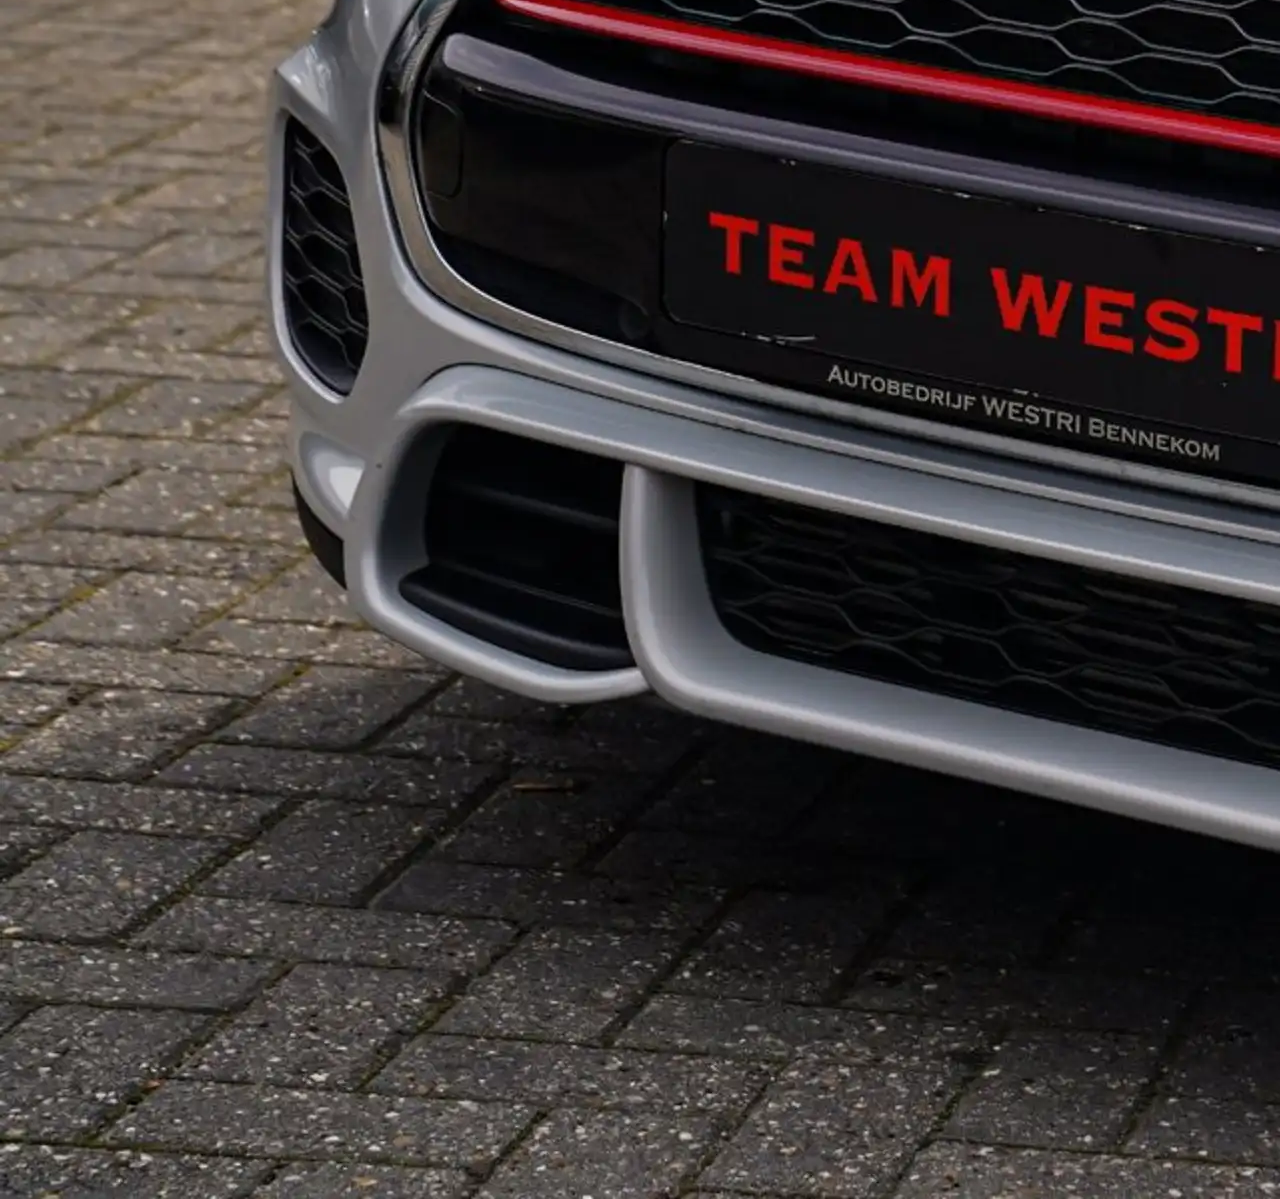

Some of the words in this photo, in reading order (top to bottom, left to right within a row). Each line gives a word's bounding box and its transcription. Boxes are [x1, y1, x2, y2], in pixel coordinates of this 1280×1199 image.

[708, 212, 951, 316] TEAM
[827, 364, 977, 412] AUTOBEDRIJF
[982, 395, 1082, 434] WESTRI
[1088, 416, 1221, 462] BENNEKOM
